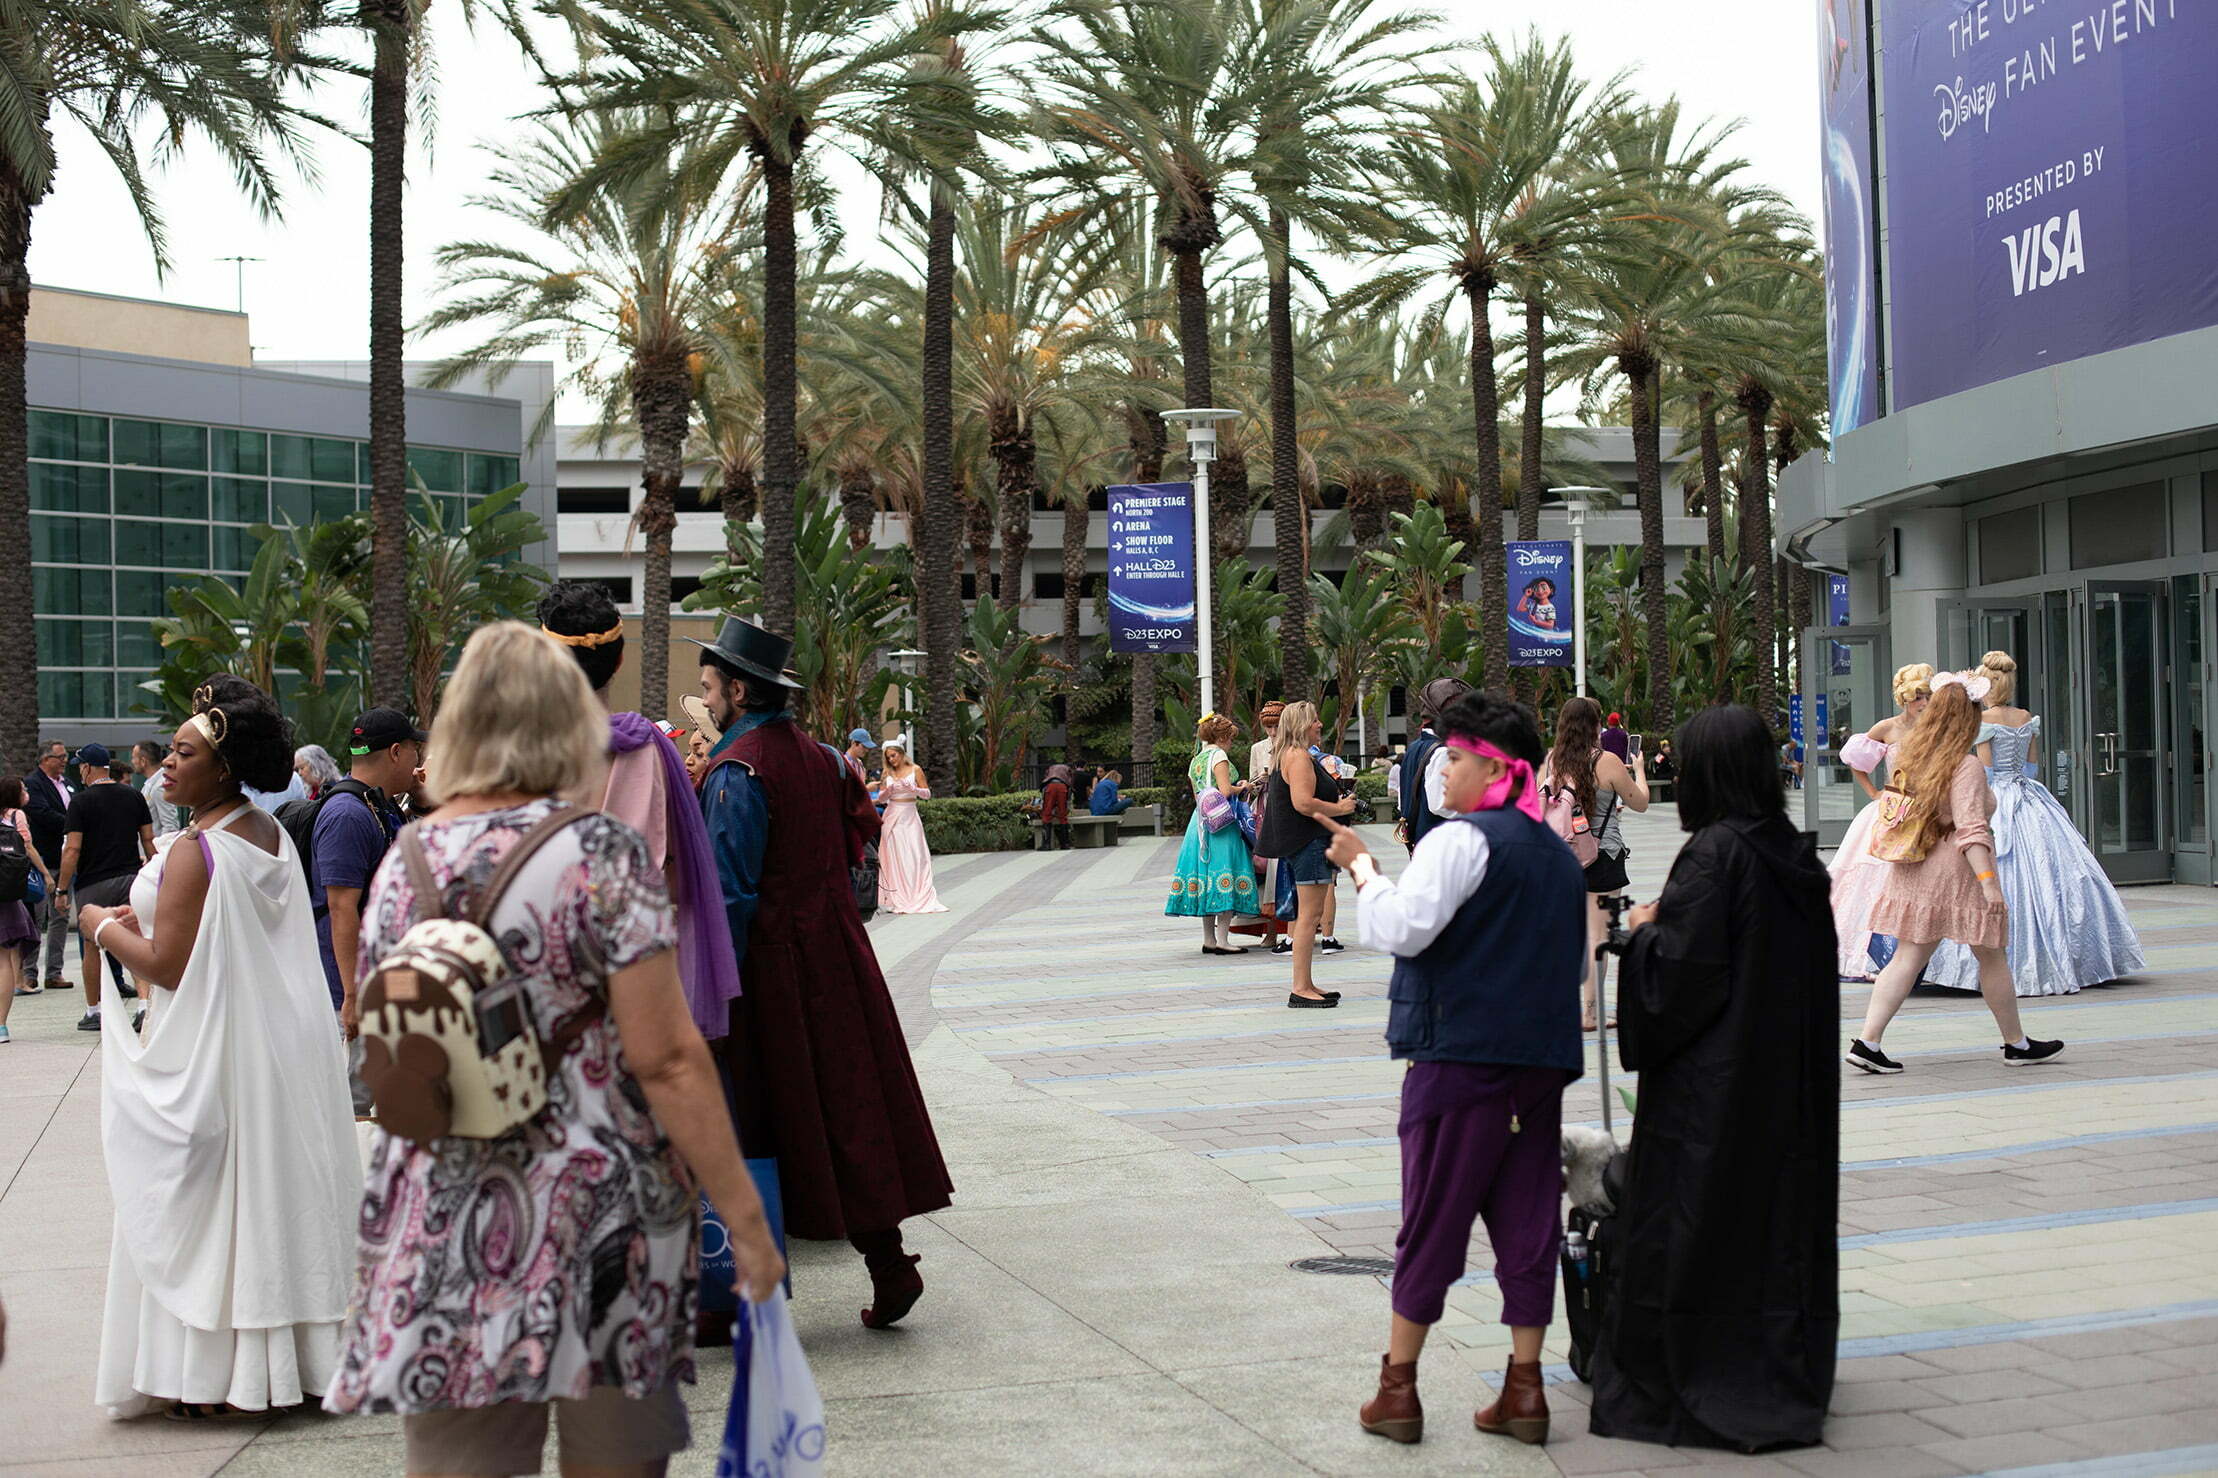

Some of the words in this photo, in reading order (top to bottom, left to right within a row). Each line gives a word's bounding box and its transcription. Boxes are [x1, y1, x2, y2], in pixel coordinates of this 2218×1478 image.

[1948, 0, 1991, 59] THE
[1933, 75, 1996, 142] Disney
[2004, 36, 2057, 99] FAN
[1986, 159, 2076, 219] PRESENTED
[2083, 146, 2105, 177] BY
[2001, 208, 2085, 297] VISA
[1125, 497, 1161, 508] PREMIERE
[1163, 496, 1186, 506] STAGE
[1125, 521, 1151, 531] ARENA
[1125, 536, 1147, 546] SHOW
[1149, 535, 1173, 545] FLOOR
[1513, 549, 1564, 569] Disney
[1832, 583, 1847, 595] PI
